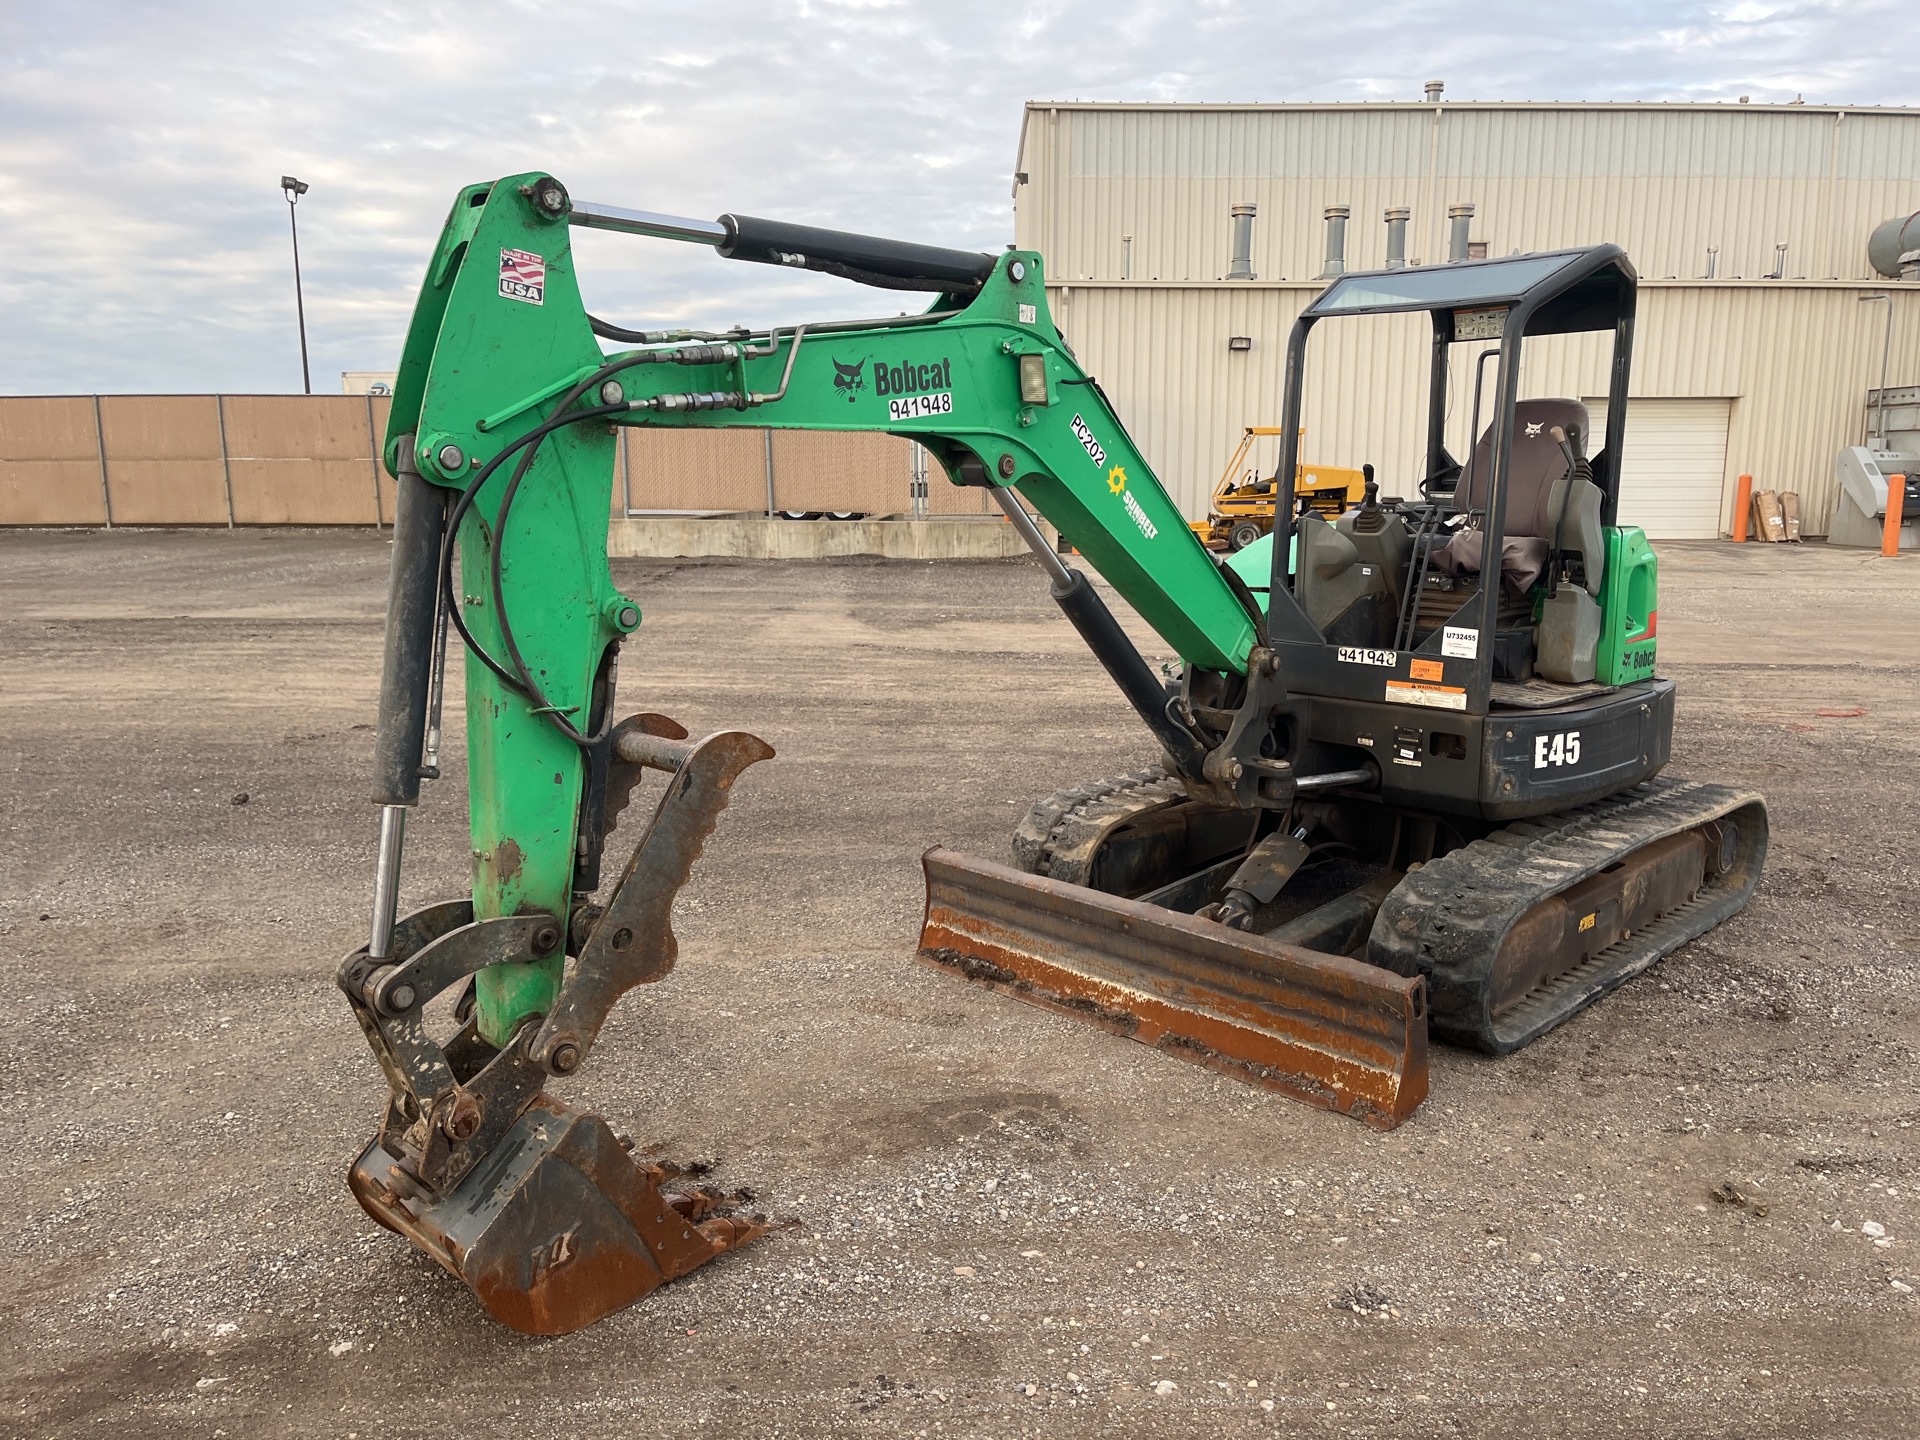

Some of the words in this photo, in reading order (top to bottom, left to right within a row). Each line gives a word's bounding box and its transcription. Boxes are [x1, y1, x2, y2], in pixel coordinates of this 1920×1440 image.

[503, 249, 522, 259] MADE
[502, 280, 540, 300] USA
[873, 357, 952, 397] Bobcat
[890, 394, 951, 418] 941948
[1070, 414, 1106, 467] PC202
[1123, 490, 1158, 540] SUNBELT
[1446, 632, 1477, 642] U732455
[1417, 684, 1442, 692] WARNING
[1534, 731, 1581, 769] E45
